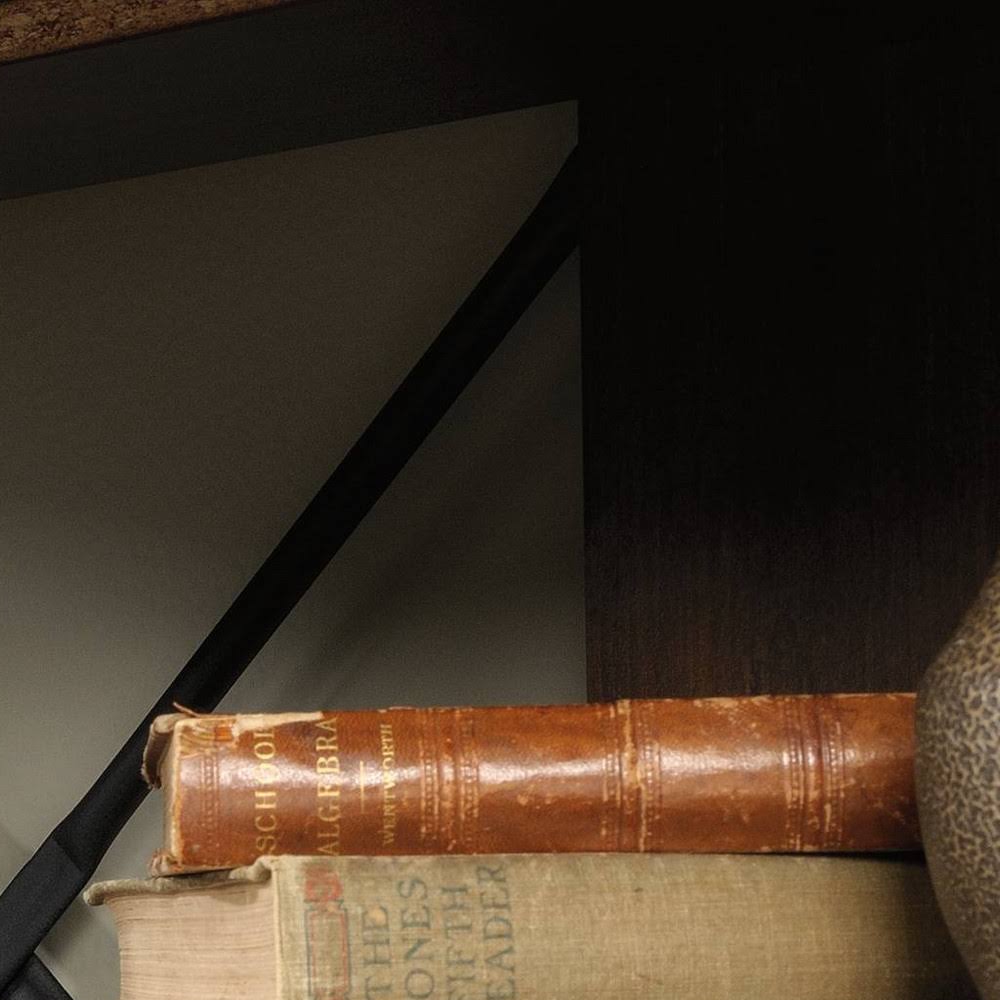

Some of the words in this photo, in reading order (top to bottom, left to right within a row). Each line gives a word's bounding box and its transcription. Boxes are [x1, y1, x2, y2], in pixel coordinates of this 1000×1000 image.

[254, 727, 278, 856] SCHOOL
[316, 717, 340, 857] ALGEBRA
[380, 724, 396, 846] WENTWORTH
